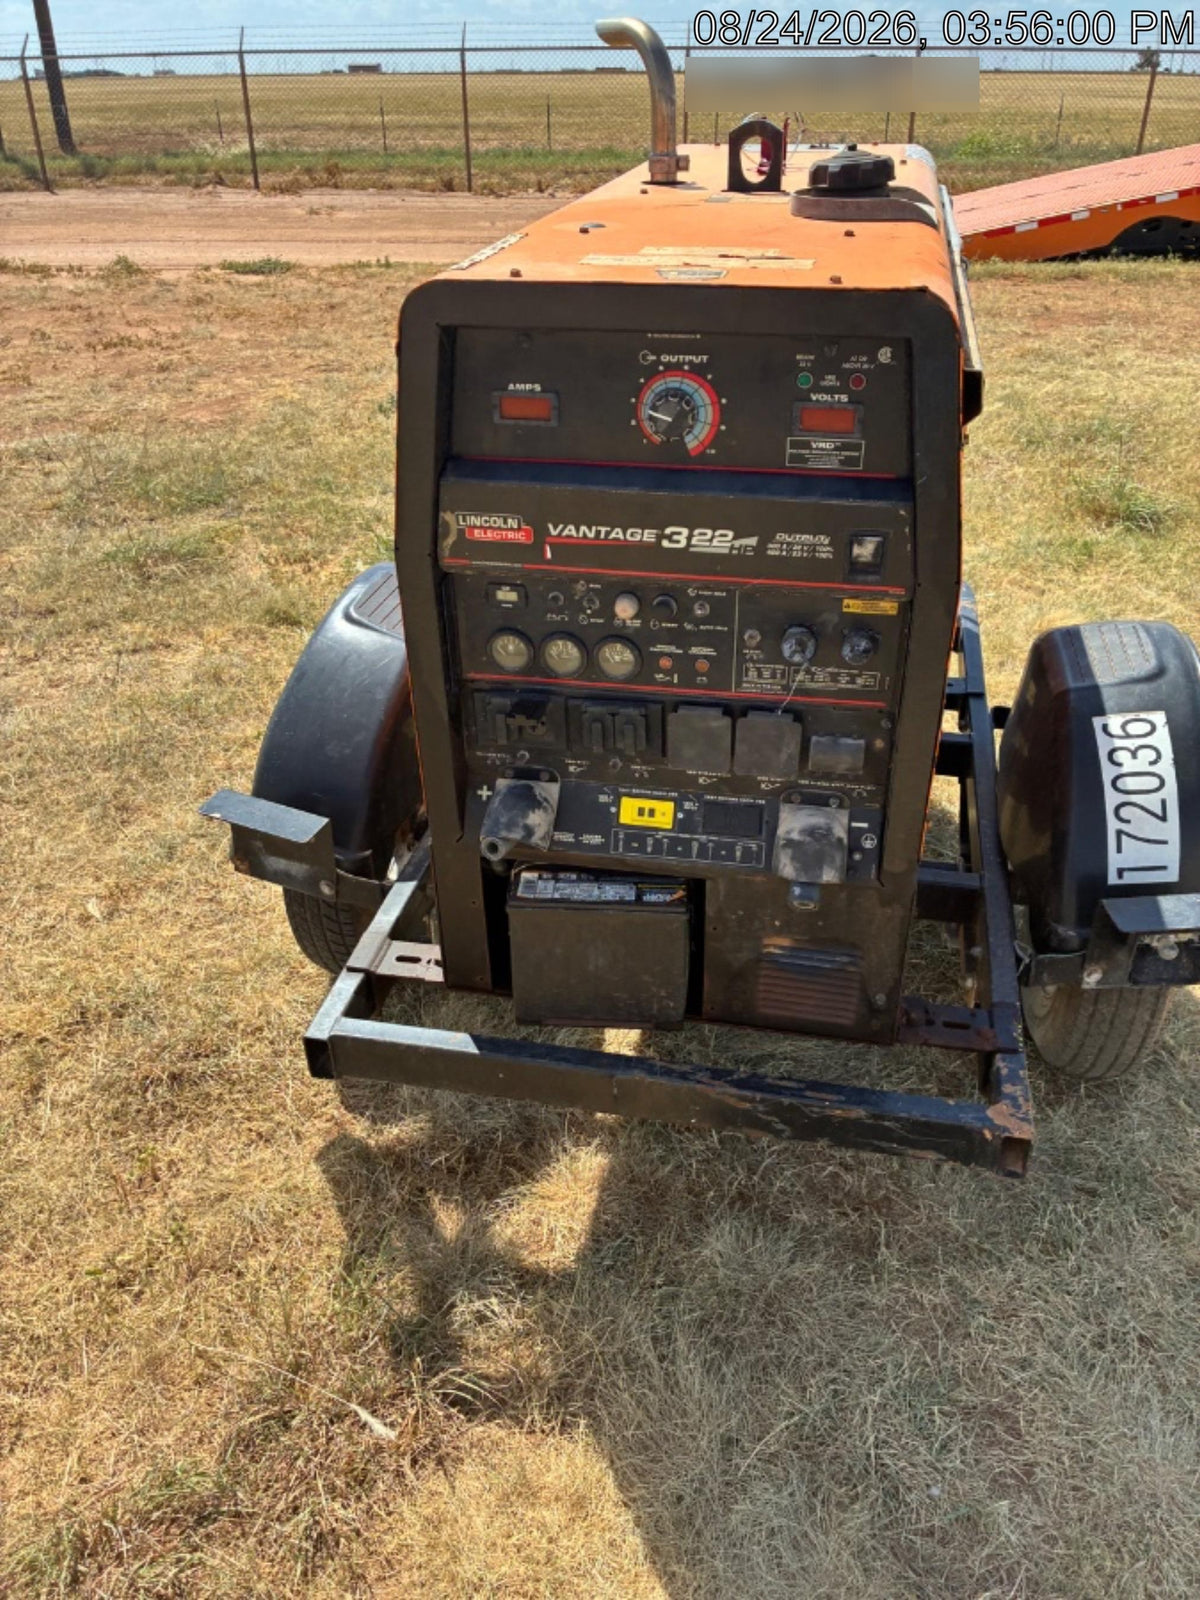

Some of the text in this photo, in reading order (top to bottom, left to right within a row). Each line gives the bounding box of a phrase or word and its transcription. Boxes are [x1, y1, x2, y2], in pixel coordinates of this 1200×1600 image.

[660, 354, 709, 364] OUTPUT
[507, 382, 542, 392] AMPS
[810, 392, 849, 402] VOLTS
[458, 515, 519, 529] LINCOLN
[473, 528, 527, 541] ELECTRIC
[547, 522, 657, 542] VANTAGE
[660, 525, 735, 549] 322
[1102, 718, 1168, 880] 172036
